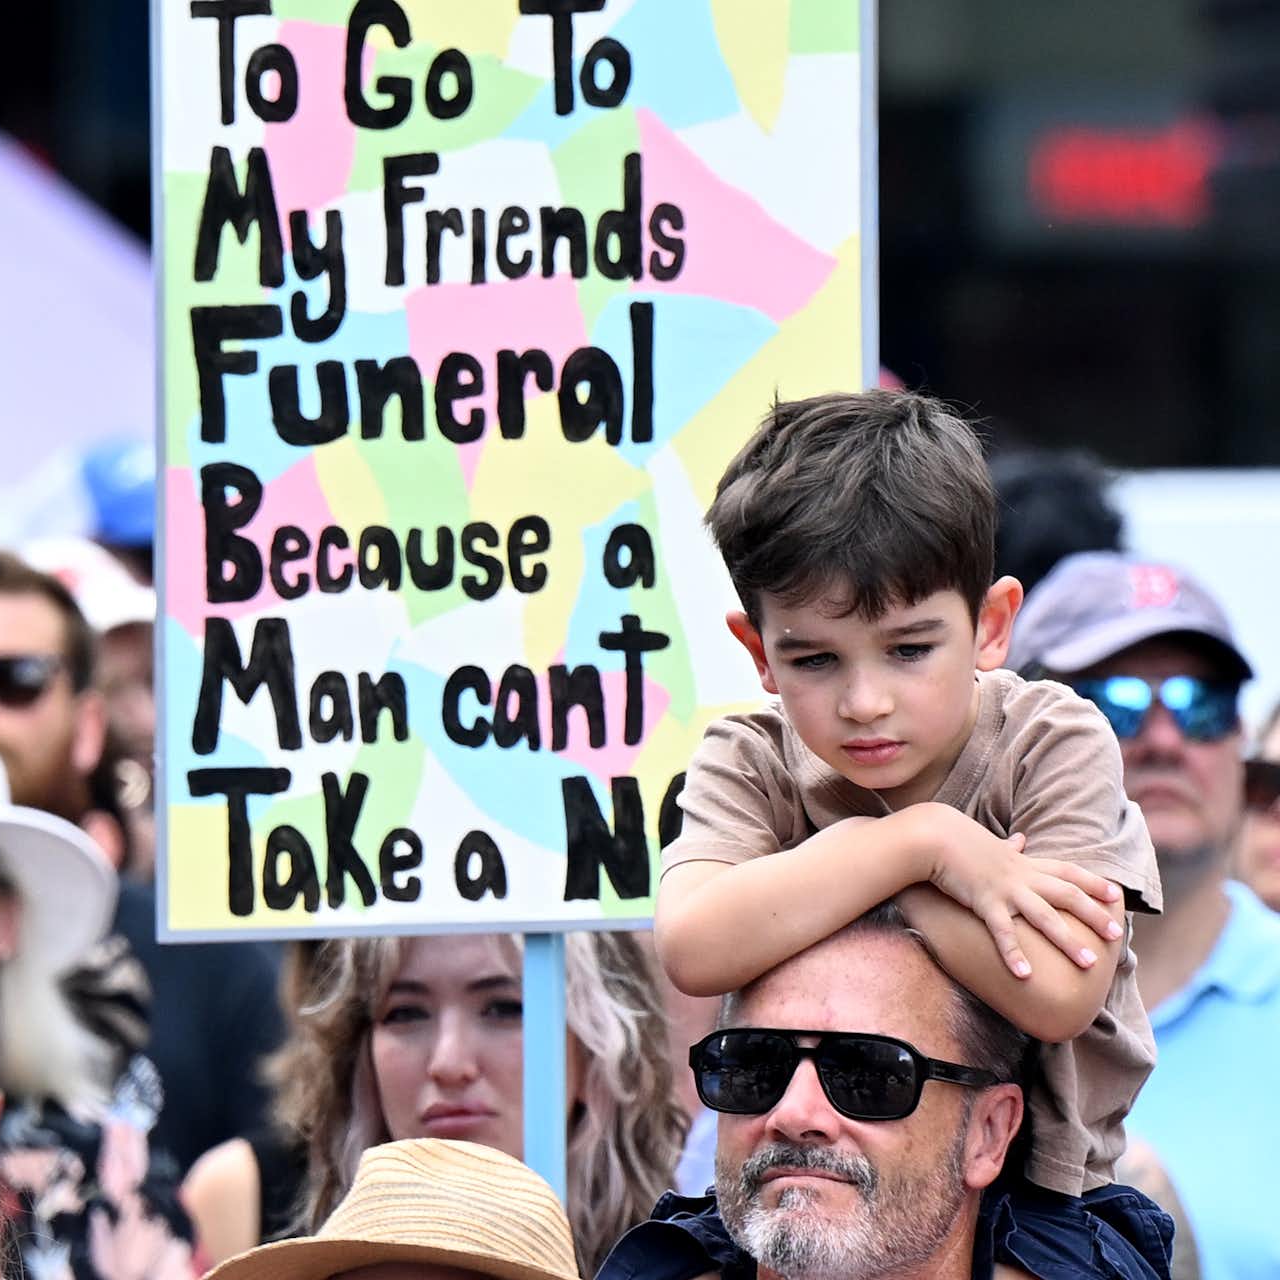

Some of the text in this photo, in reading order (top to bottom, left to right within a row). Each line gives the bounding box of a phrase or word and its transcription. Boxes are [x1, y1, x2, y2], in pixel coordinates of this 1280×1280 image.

[191, 0, 633, 130] To Go To
[193, 145, 686, 343] My Friends
[189, 301, 655, 447] Funeral
[200, 461, 655, 604] Because a
[190, 613, 671, 756] Man cant
[186, 766, 423, 917] Take
[454, 829, 509, 901] a
